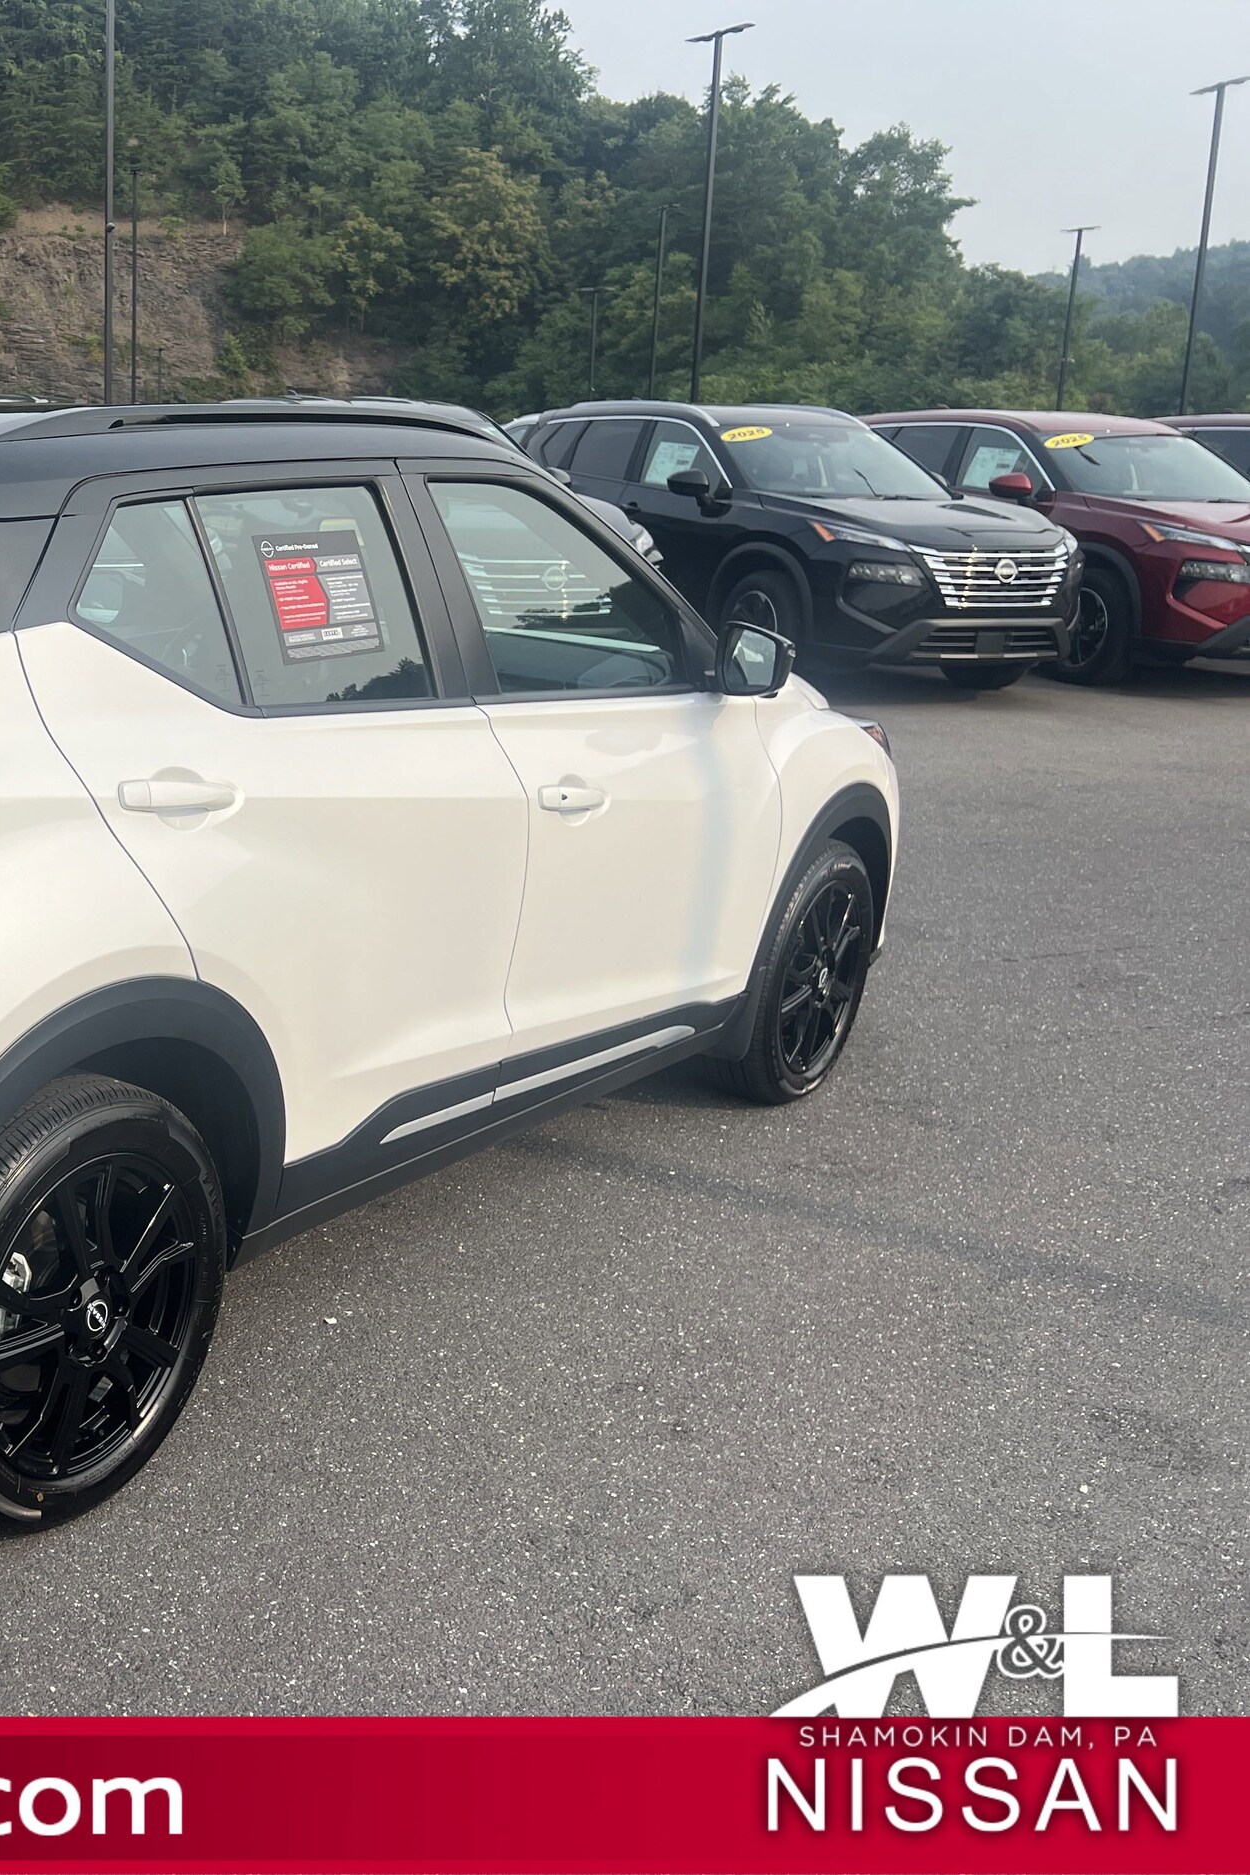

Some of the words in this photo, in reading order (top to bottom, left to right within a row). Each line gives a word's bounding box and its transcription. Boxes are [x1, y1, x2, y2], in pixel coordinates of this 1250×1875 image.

[1050, 434, 1088, 447] 2025
[319, 559, 341, 567] Certified
[341, 558, 358, 566] Select
[87, 1303, 106, 1328] NISSAN
